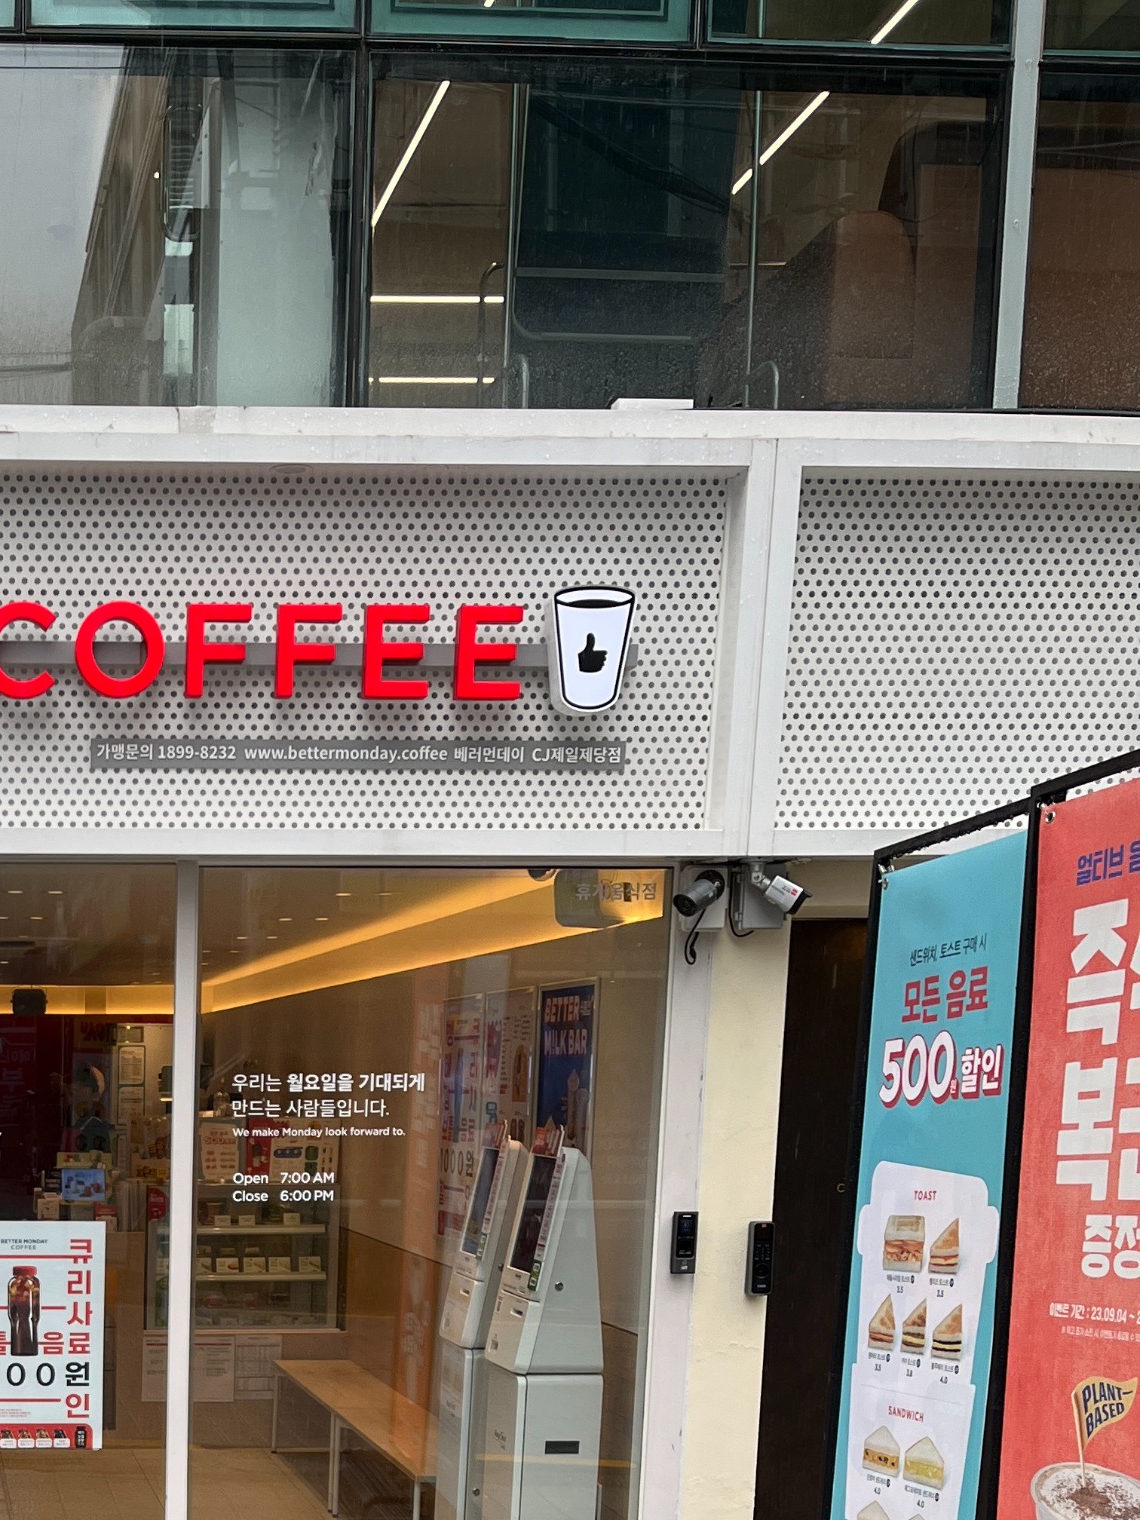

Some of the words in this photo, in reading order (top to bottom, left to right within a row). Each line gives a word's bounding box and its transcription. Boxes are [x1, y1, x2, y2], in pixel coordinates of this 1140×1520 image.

[96, 743, 154, 761] 가맹문의
[157, 744, 237, 761] 1899-8232
[244, 745, 448, 765] www.bettermonday.coffee
[454, 745, 525, 764] 베러먼데이
[531, 745, 622, 765] CJ제일제당점
[1075, 844, 1124, 886] 얼티브
[939, 939, 962, 959] 토스트
[962, 934, 978, 955] 구매
[979, 932, 988, 951] 시
[901, 974, 941, 1023] 모든
[946, 965, 989, 1020] 음료
[544, 995, 580, 1022] BETTER
[568, 1028, 588, 1055] BAR
[231, 1073, 282, 1092] 우리는
[286, 1072, 354, 1092] 월요일을
[358, 1072, 425, 1092] 기대되게
[961, 1043, 1005, 1099] 할인
[231, 1098, 281, 1118] 만드는
[286, 1098, 390, 1118] 사람들입니다.
[232, 1128, 250, 1137] We
[251, 1127, 279, 1137] make
[282, 1127, 323, 1138] Monday
[325, 1126, 348, 1136] look
[349, 1126, 390, 1137] forward
[392, 1128, 406, 1136] to.
[232, 1172, 269, 1186] Open
[280, 1172, 311, 1184] 7:00
[312, 1172, 335, 1184] AM
[232, 1190, 269, 1202] Close
[280, 1190, 311, 1202] 6:00
[314, 1190, 335, 1202] PM
[913, 1190, 938, 1201] TOAST
[1070, 1303, 1085, 1320] 기간
[1090, 1306, 1128, 1324] 23.09.04
[42, 1331, 91, 1356] 음료
[1081, 1381, 1133, 1415] PLANT-
[888, 1405, 925, 1422] SANDWICH
[1085, 1402, 1126, 1438] BASED
